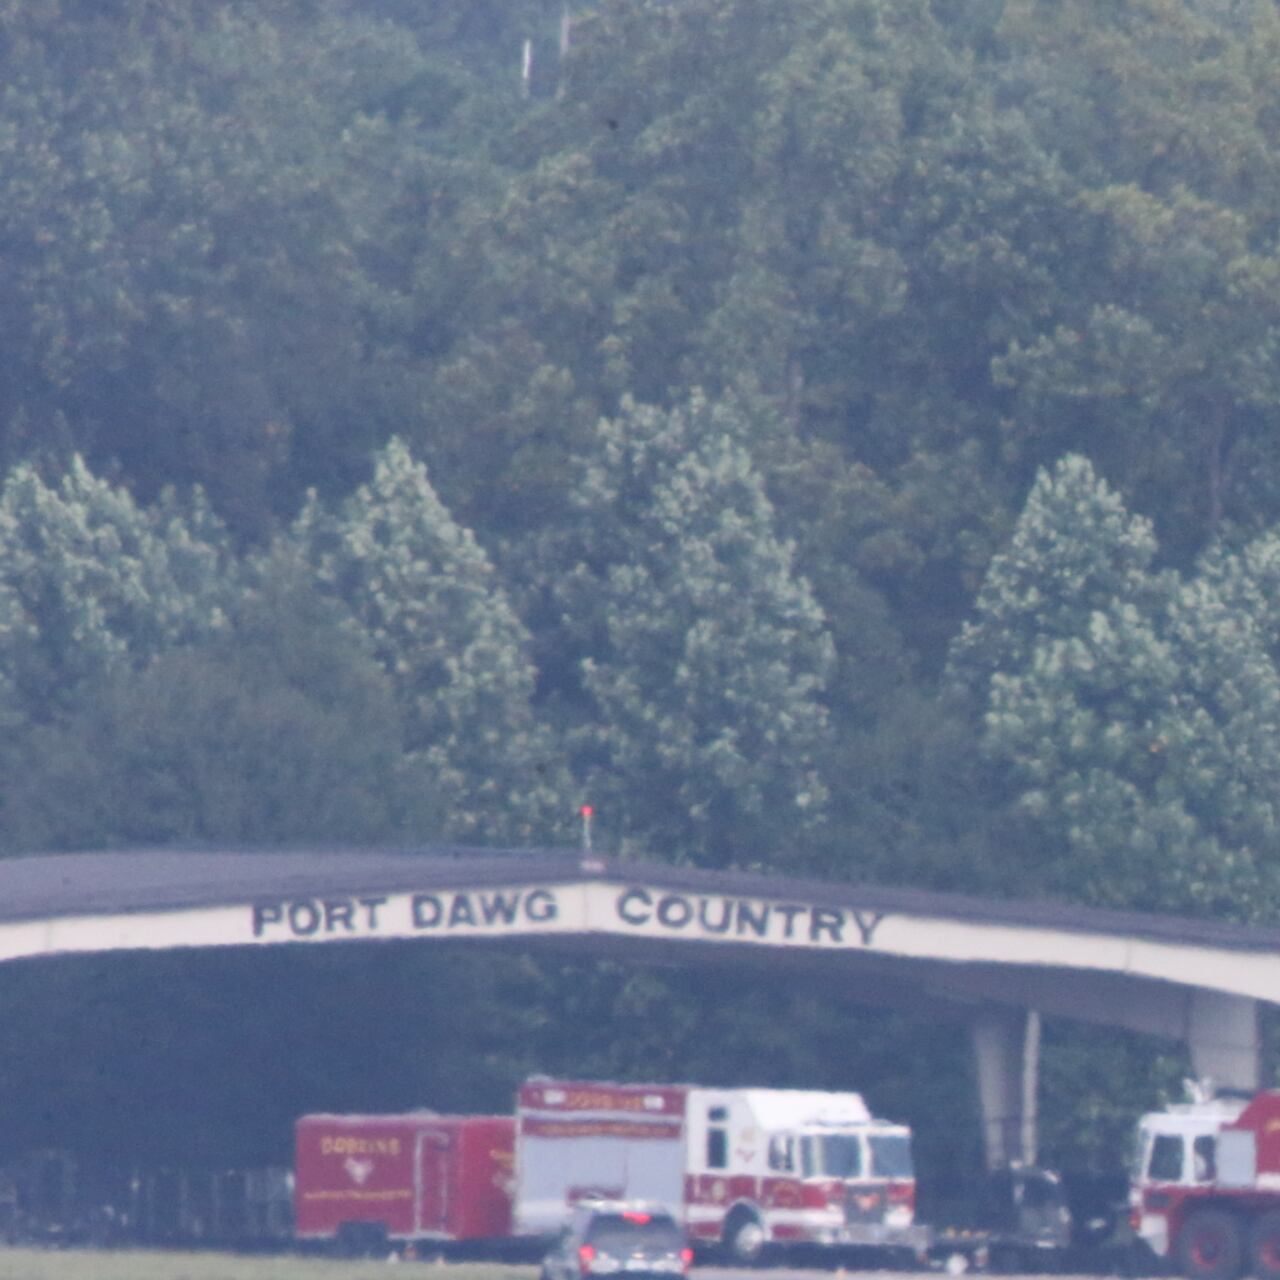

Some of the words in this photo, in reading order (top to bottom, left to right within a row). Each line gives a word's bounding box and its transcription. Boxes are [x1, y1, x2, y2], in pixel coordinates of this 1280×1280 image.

[252, 897, 388, 937] PORT
[410, 889, 558, 929] DAWG
[616, 886, 886, 946] COUNTRY
